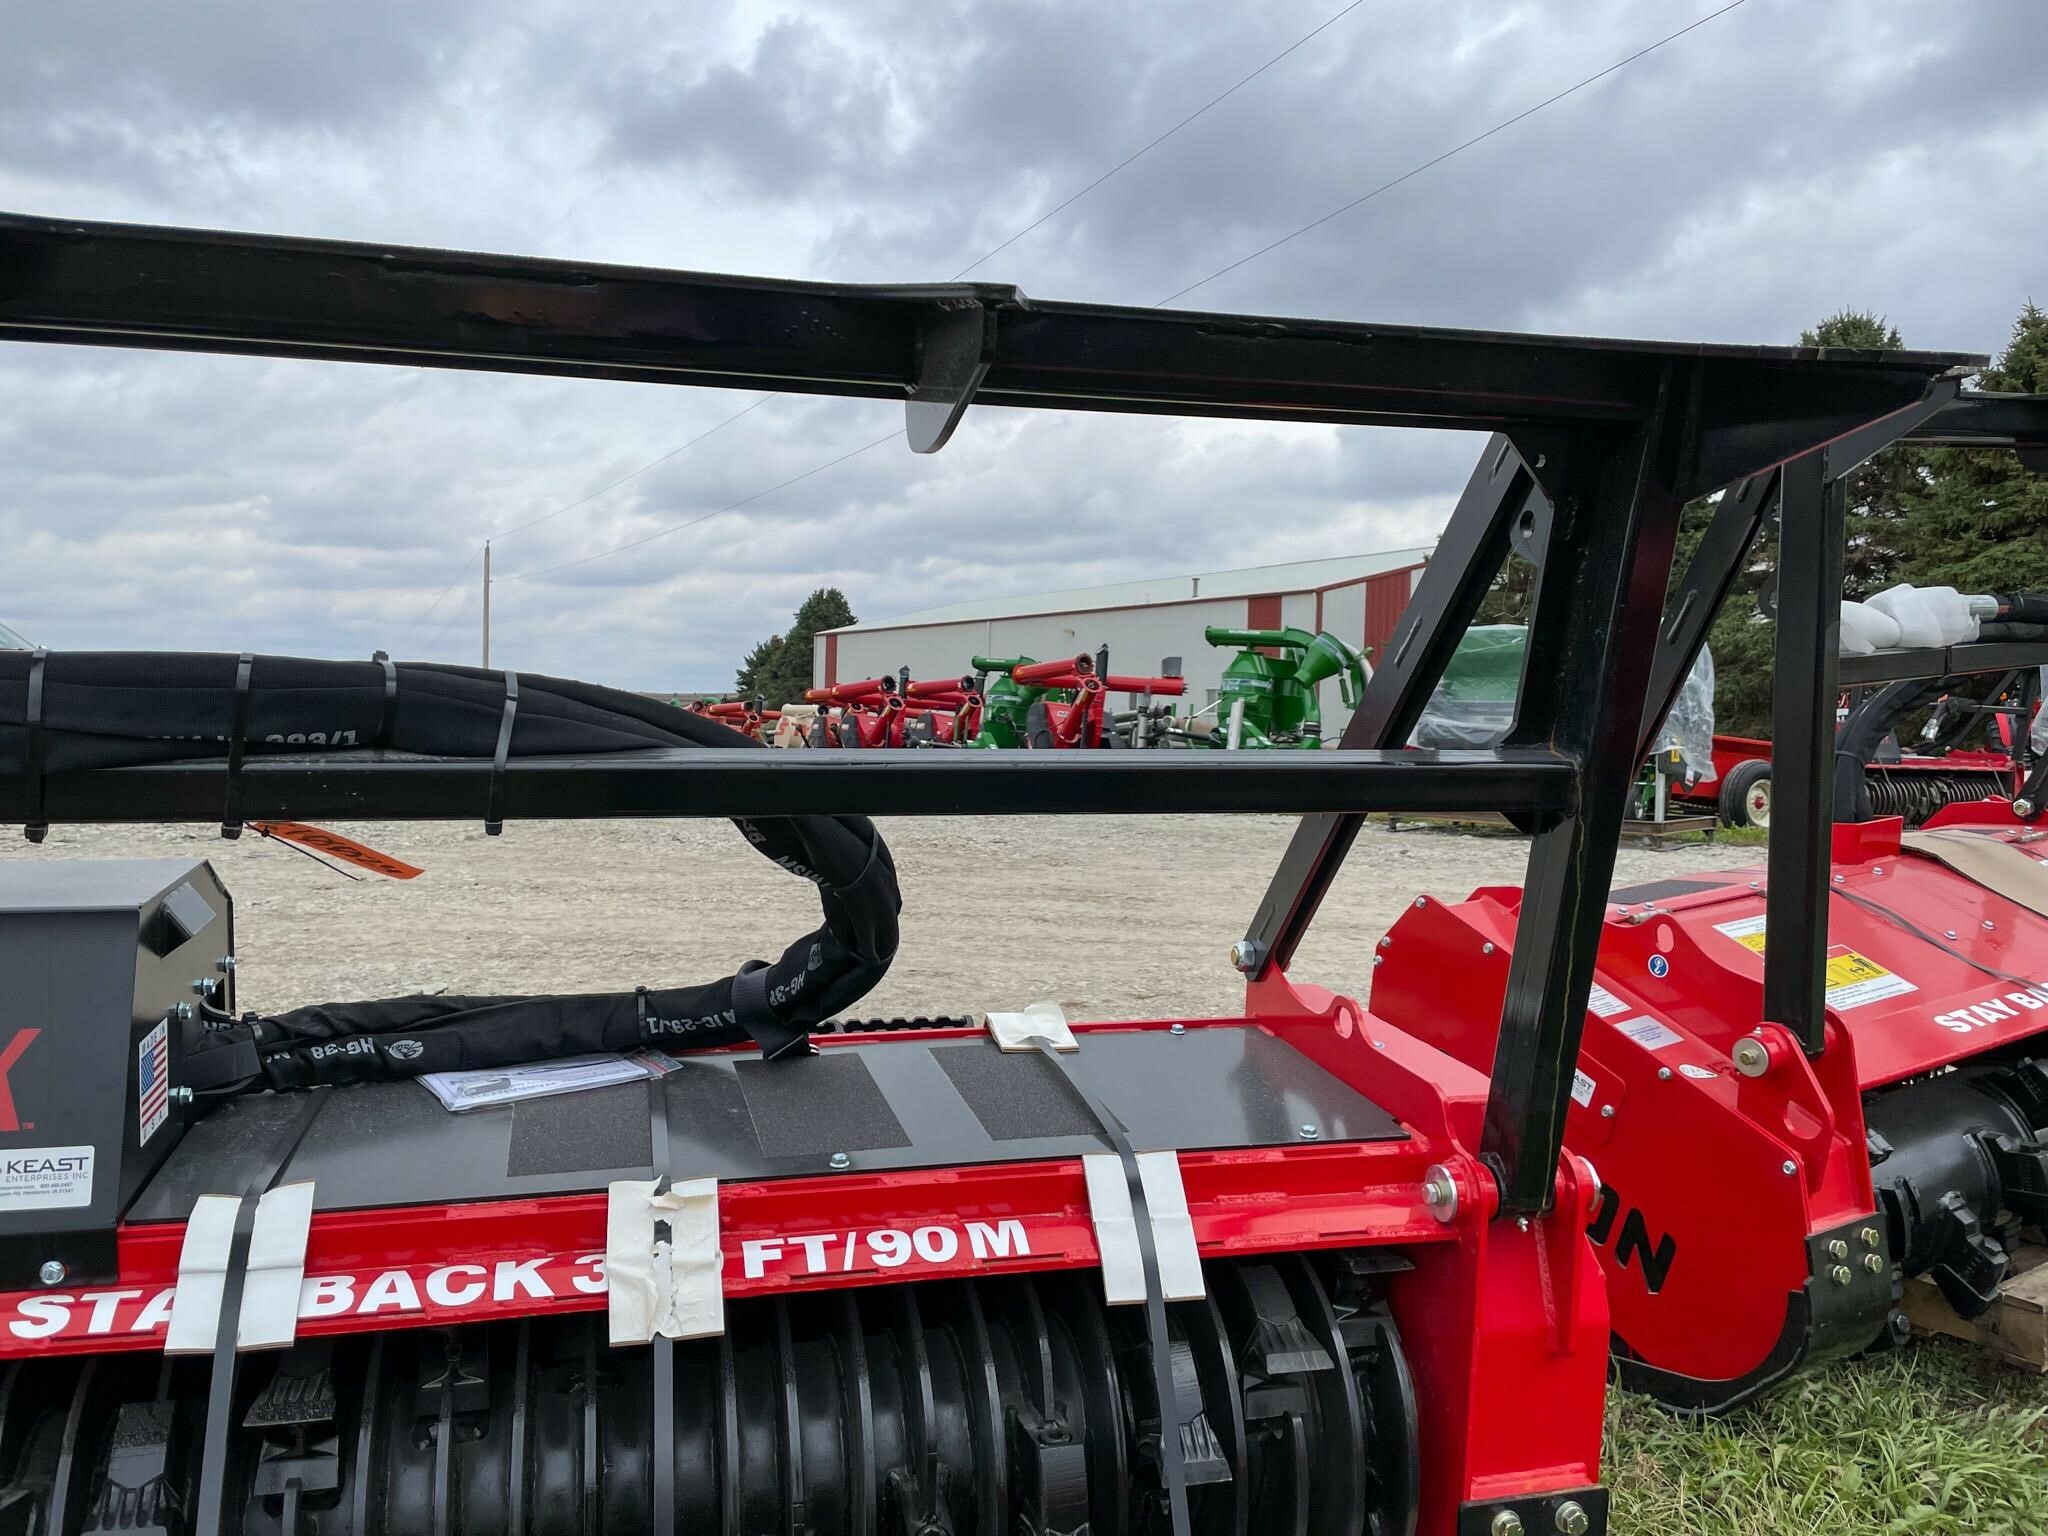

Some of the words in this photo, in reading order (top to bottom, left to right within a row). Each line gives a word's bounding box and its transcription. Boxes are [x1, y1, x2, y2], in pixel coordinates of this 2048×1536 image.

[1933, 998, 2021, 1033] STAY
[142, 1031, 158, 1053] MADE
[311, 1037, 376, 1060] HG-38
[6, 1173, 69, 1183] ENTERPRISES
[72, 1171, 89, 1180] INC
[7, 1157, 89, 1175] KEAST
[299, 1257, 558, 1318] BACK
